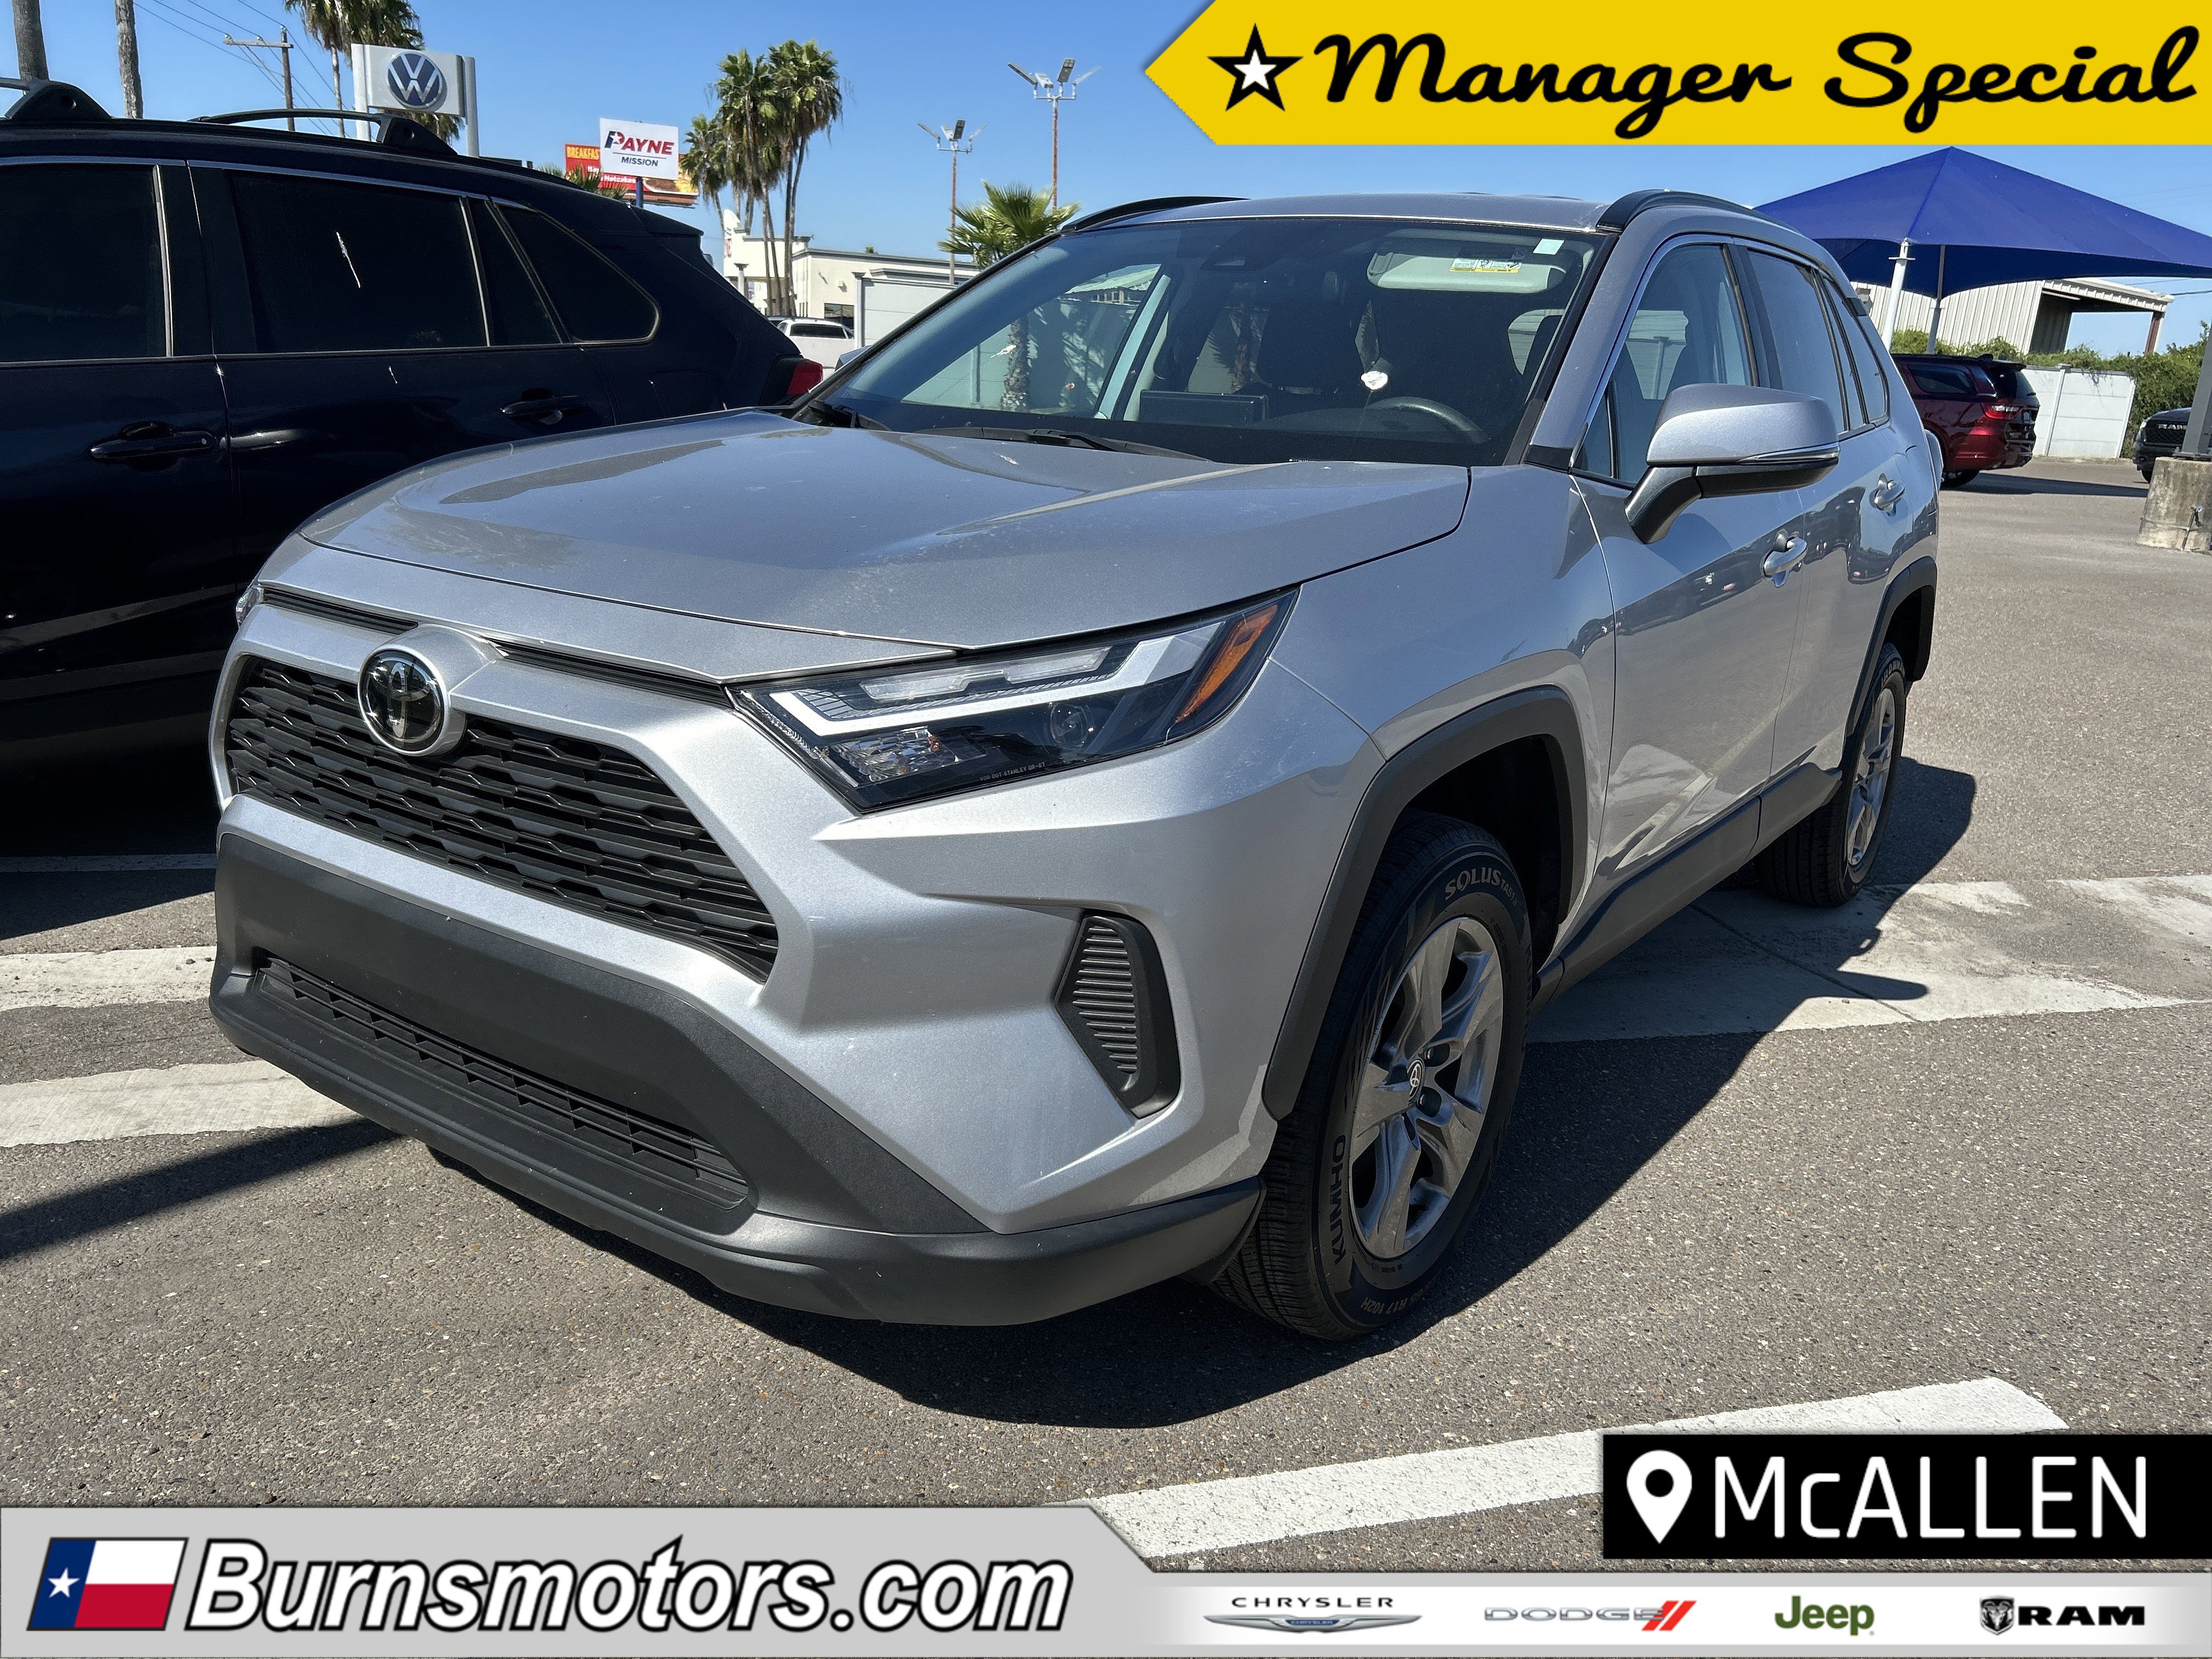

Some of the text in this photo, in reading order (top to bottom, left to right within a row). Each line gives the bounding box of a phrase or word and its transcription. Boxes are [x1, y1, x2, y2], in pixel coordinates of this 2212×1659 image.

[604, 131, 674, 155] PAYNE
[566, 146, 600, 161] BREAKFAS
[621, 156, 658, 167] MISSION
[1003, 766, 1027, 776] STANLEY
[1444, 867, 1502, 901] SOLUS
[1330, 1135, 1346, 1266] KUMHO
